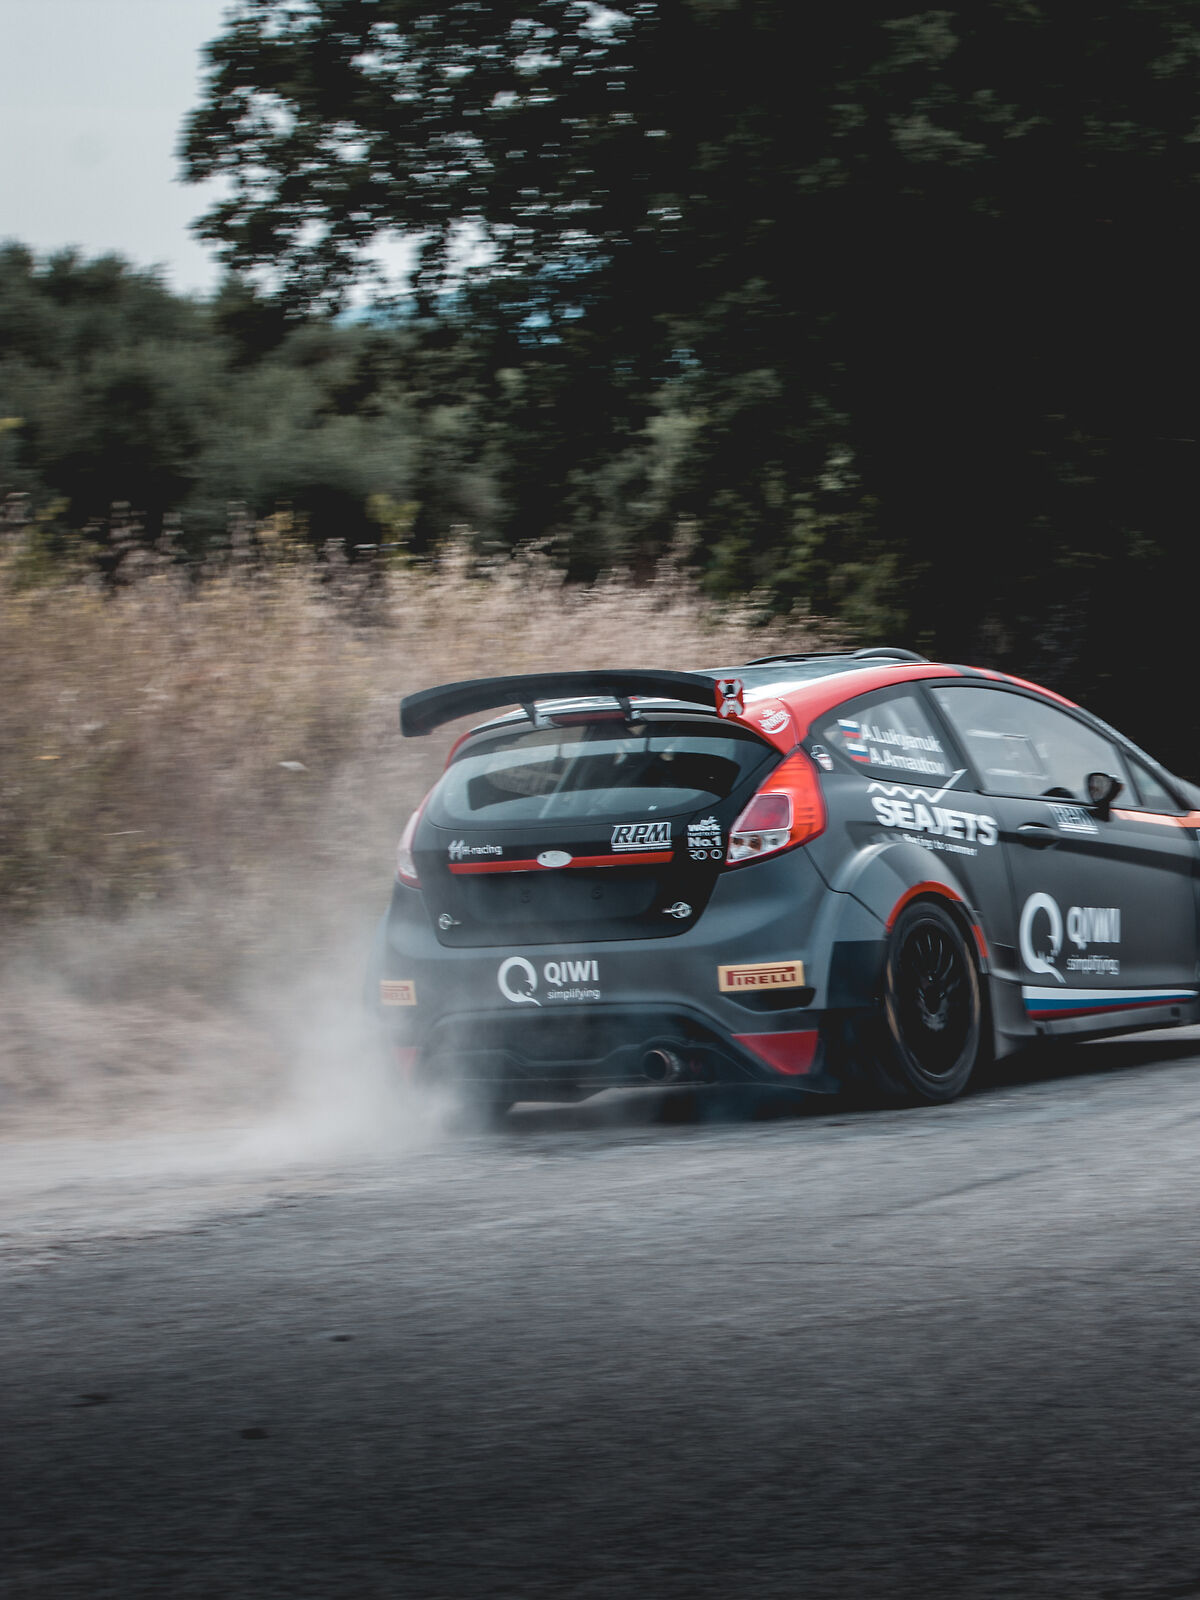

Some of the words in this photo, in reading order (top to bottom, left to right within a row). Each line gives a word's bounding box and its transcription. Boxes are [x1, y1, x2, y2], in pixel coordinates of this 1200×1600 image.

[611, 822, 671, 844] RPM
[872, 796, 998, 846] SEAJETS
[1066, 906, 1120, 950] QIWI
[543, 960, 600, 987] QIWI
[727, 966, 795, 985] PIRELLI
[547, 988, 600, 1000] simplifying
